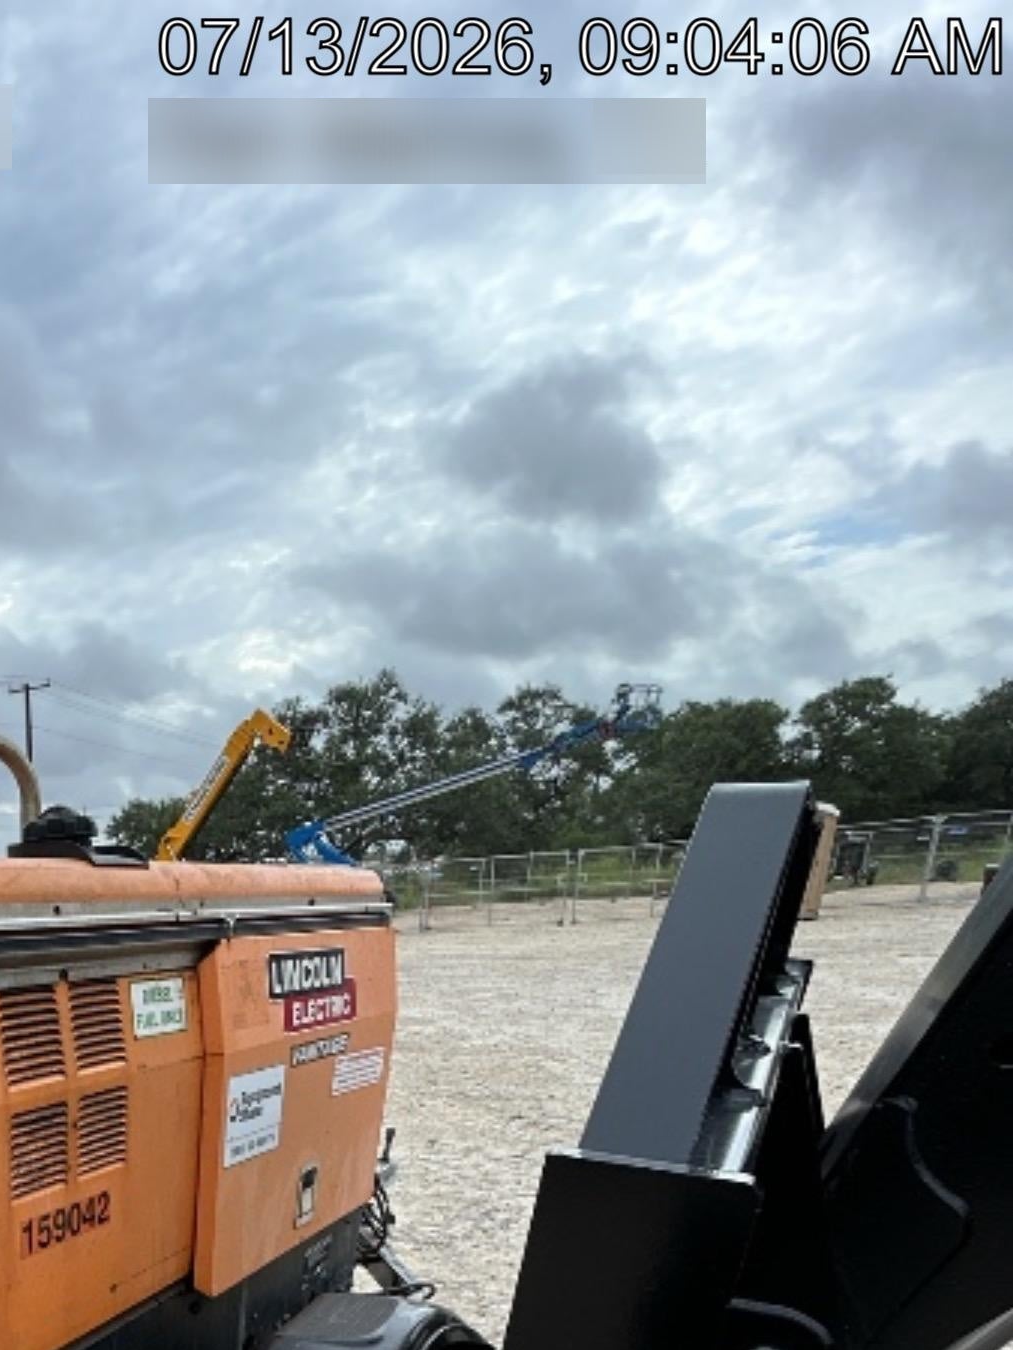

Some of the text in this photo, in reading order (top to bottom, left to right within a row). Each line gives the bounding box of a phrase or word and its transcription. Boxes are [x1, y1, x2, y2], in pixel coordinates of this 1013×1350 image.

[271, 953, 342, 994] LINCOLN
[292, 993, 351, 1026] ELECTRIC
[22, 1190, 110, 1256] 159042
